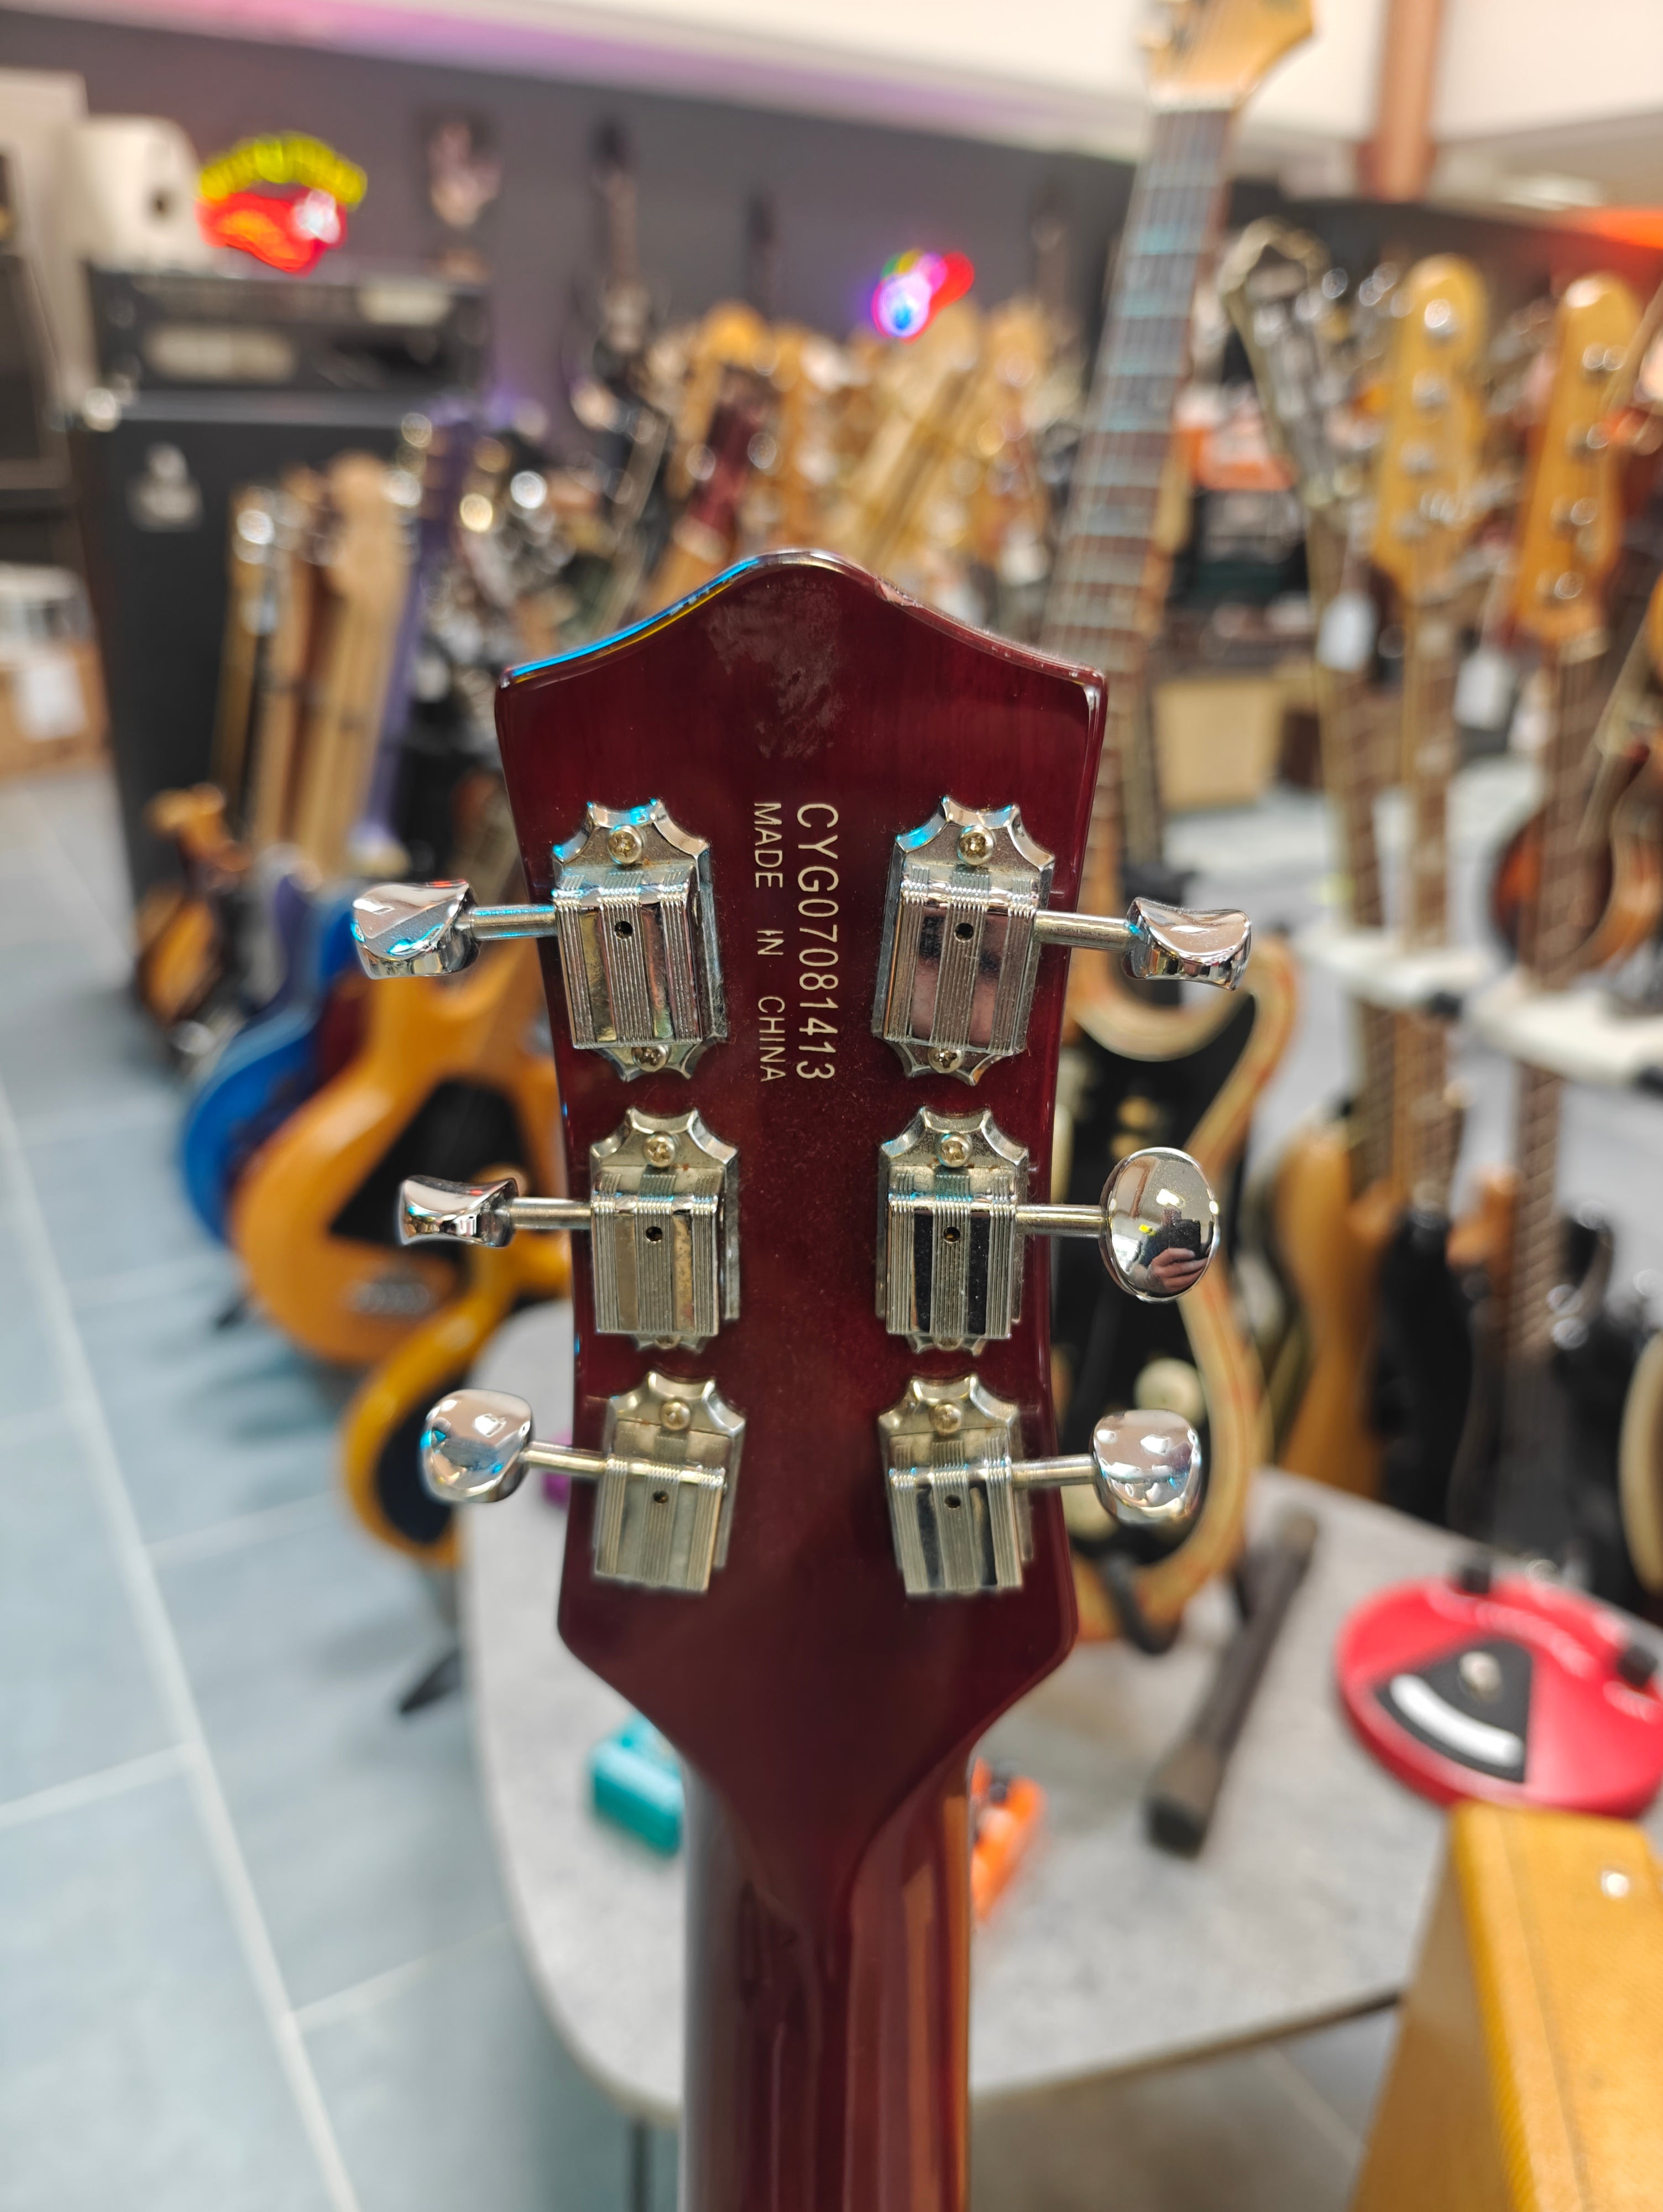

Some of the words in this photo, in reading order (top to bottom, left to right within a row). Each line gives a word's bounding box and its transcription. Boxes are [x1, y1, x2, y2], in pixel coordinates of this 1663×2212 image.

[754, 802, 783, 888] MADE
[756, 930, 784, 956] IN
[796, 803, 839, 1079] CYG07081413
[757, 996, 786, 1082] CHINA
